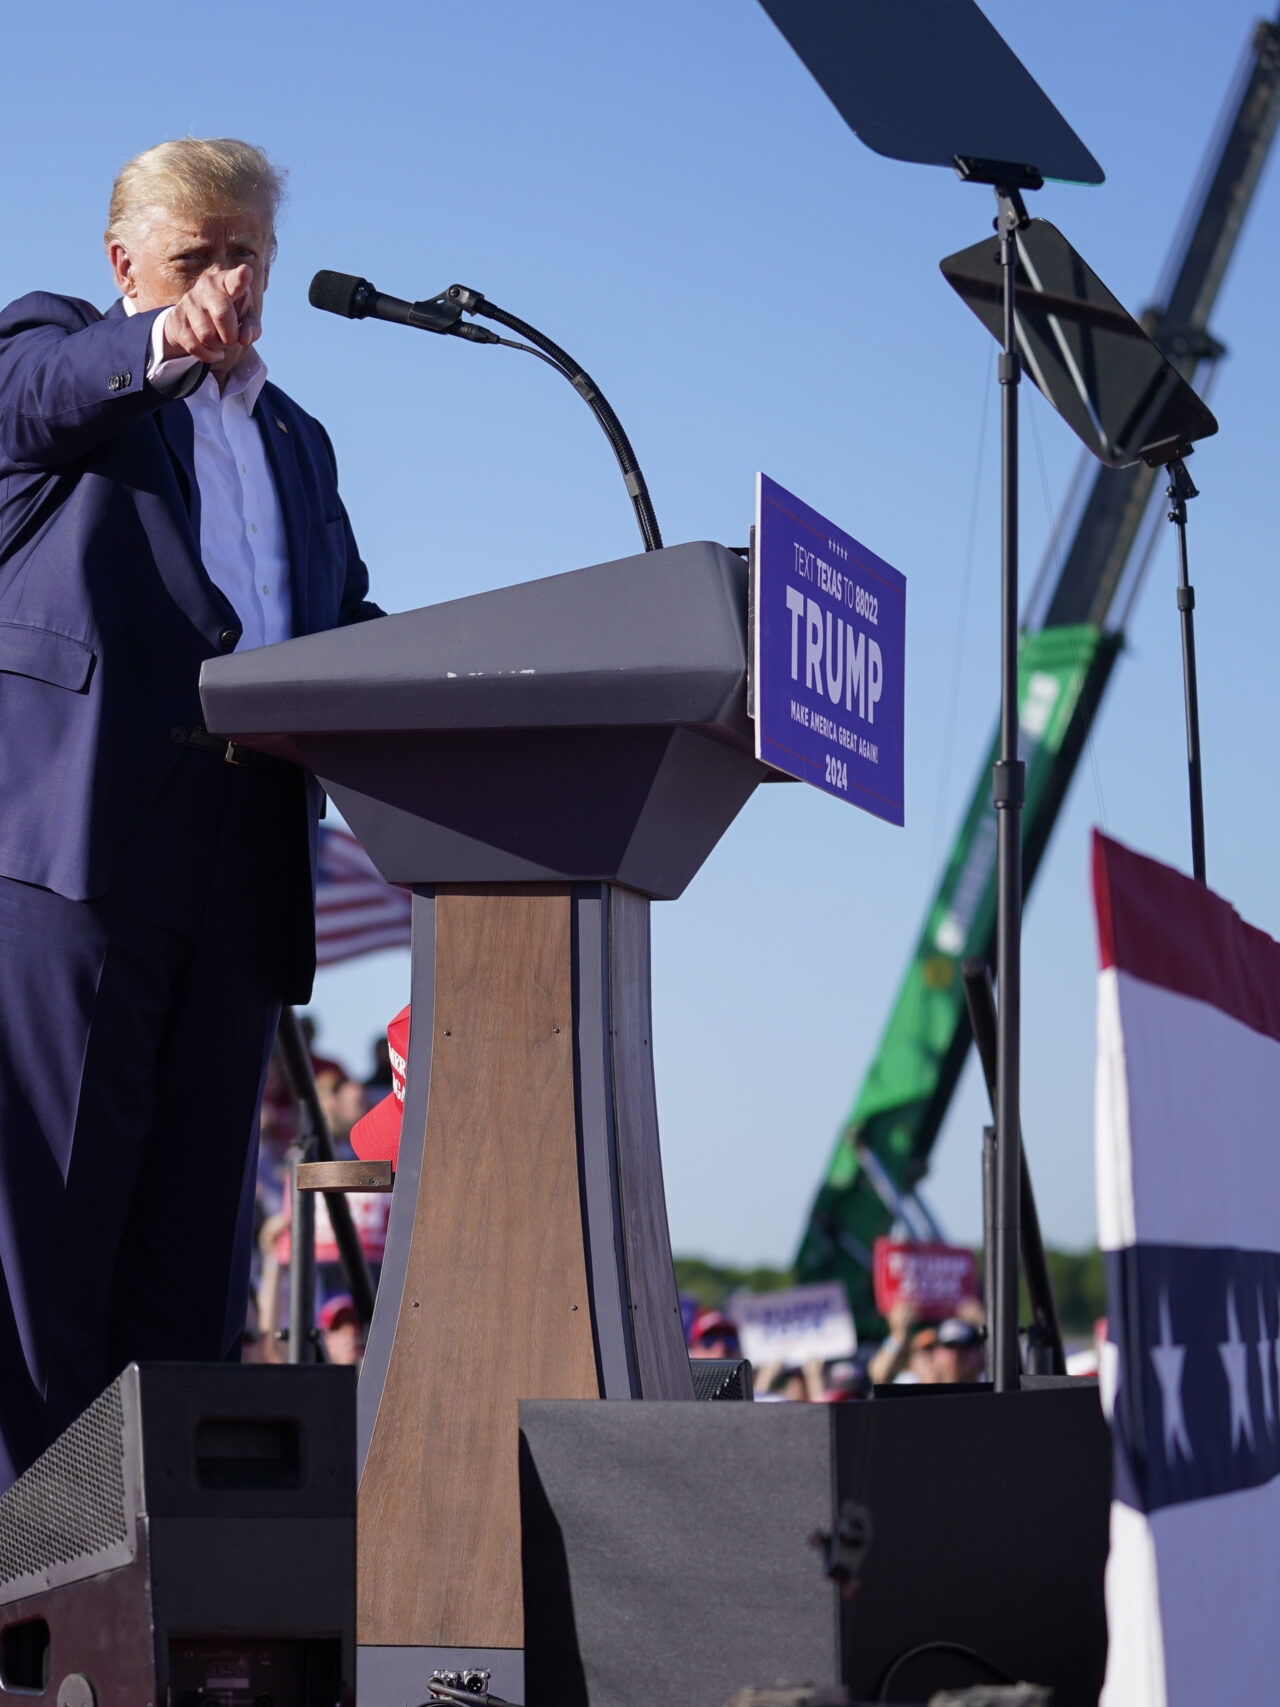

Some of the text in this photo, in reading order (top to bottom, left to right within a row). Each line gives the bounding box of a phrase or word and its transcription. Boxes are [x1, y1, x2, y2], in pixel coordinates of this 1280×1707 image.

[794, 542, 878, 625] TEXT TEXAS TO 88022
[786, 585, 883, 724] TRUMP
[791, 699, 879, 764] MAKE AMERICA GREAT AGAIN!
[825, 754, 848, 791] 2024
